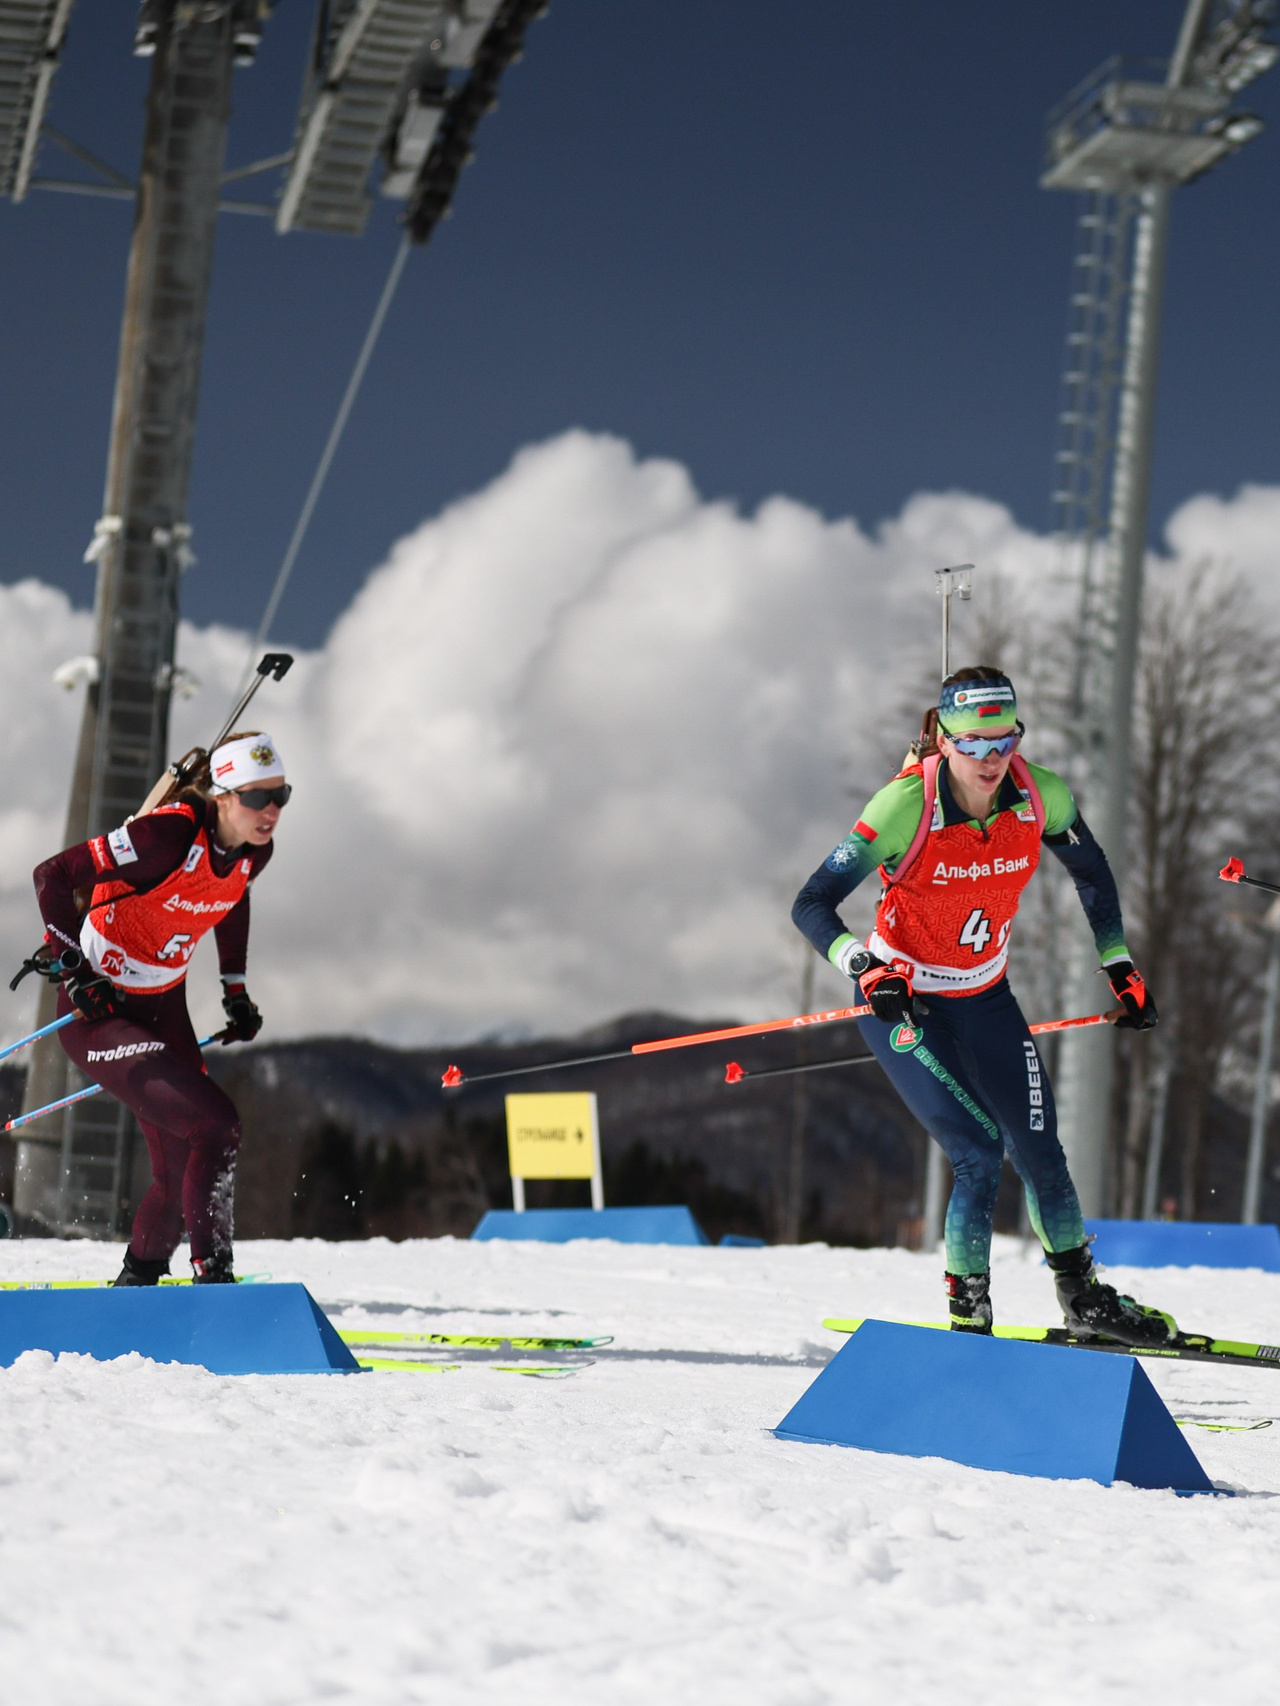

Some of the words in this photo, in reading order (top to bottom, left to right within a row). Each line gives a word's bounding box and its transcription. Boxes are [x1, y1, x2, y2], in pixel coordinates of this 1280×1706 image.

[932, 862, 991, 885] Альфа
[993, 855, 1029, 874] Банк
[162, 893, 208, 915] Альфа
[958, 908, 991, 954] 4
[86, 1041, 165, 1062] proteam
[1023, 1041, 1043, 1106] BEEU
[913, 1045, 999, 1140] БЕЛОРУСНЕФТЬ
[1129, 1347, 1181, 1357] FISCHER
